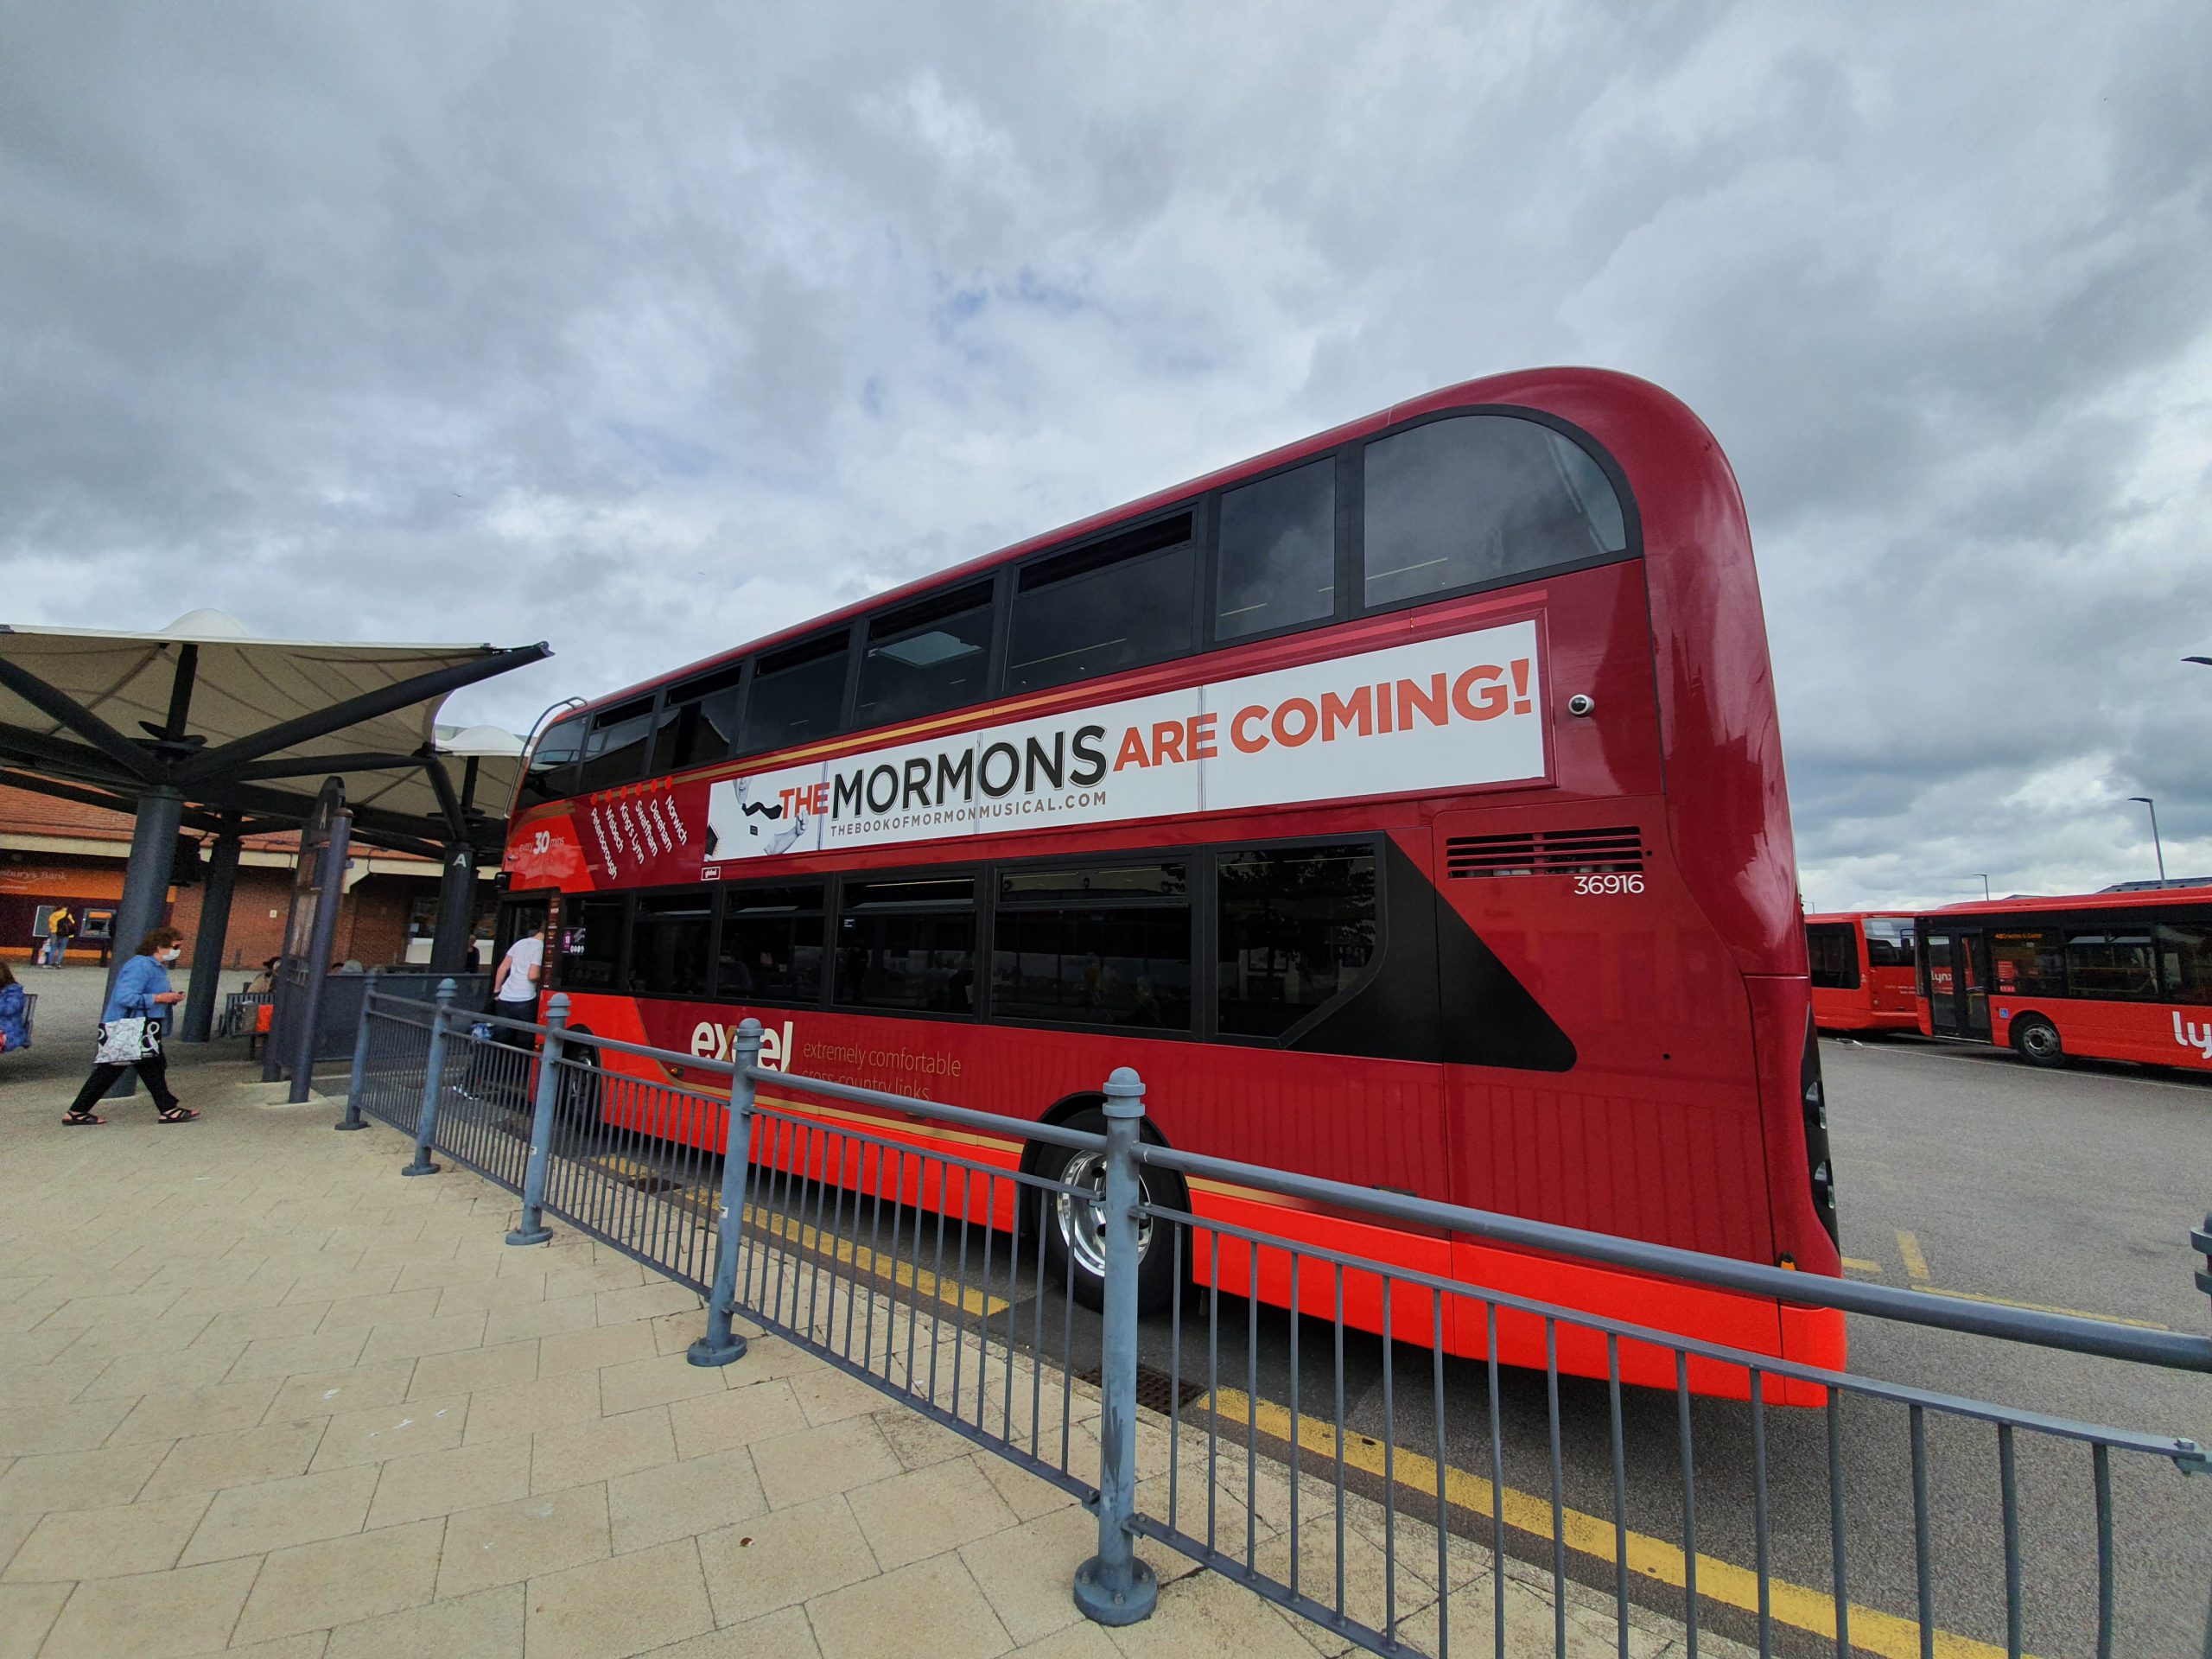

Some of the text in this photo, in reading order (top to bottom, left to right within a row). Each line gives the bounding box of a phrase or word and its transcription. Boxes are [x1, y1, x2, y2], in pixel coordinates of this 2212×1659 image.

[779, 658, 1533, 820] THE MORMONS ARE COMING!
[606, 804, 624, 854] Wisbech
[620, 801, 645, 865] King's Lynn
[635, 799, 658, 857] Swaffham
[650, 798, 673, 853] Dereham
[664, 794, 688, 846] Norwich
[830, 791, 1106, 837] THEBOOKOFMORMONMUSICAL.COM
[453, 853, 467, 868] A
[532, 830, 550, 855] 30
[550, 836, 565, 847] mins
[591, 807, 618, 880] Peterborough
[1573, 874, 1645, 895] 36916
[691, 1021, 793, 1072] exel
[803, 1041, 961, 1077] extremely comfortable
[895, 1077, 931, 1101] links
